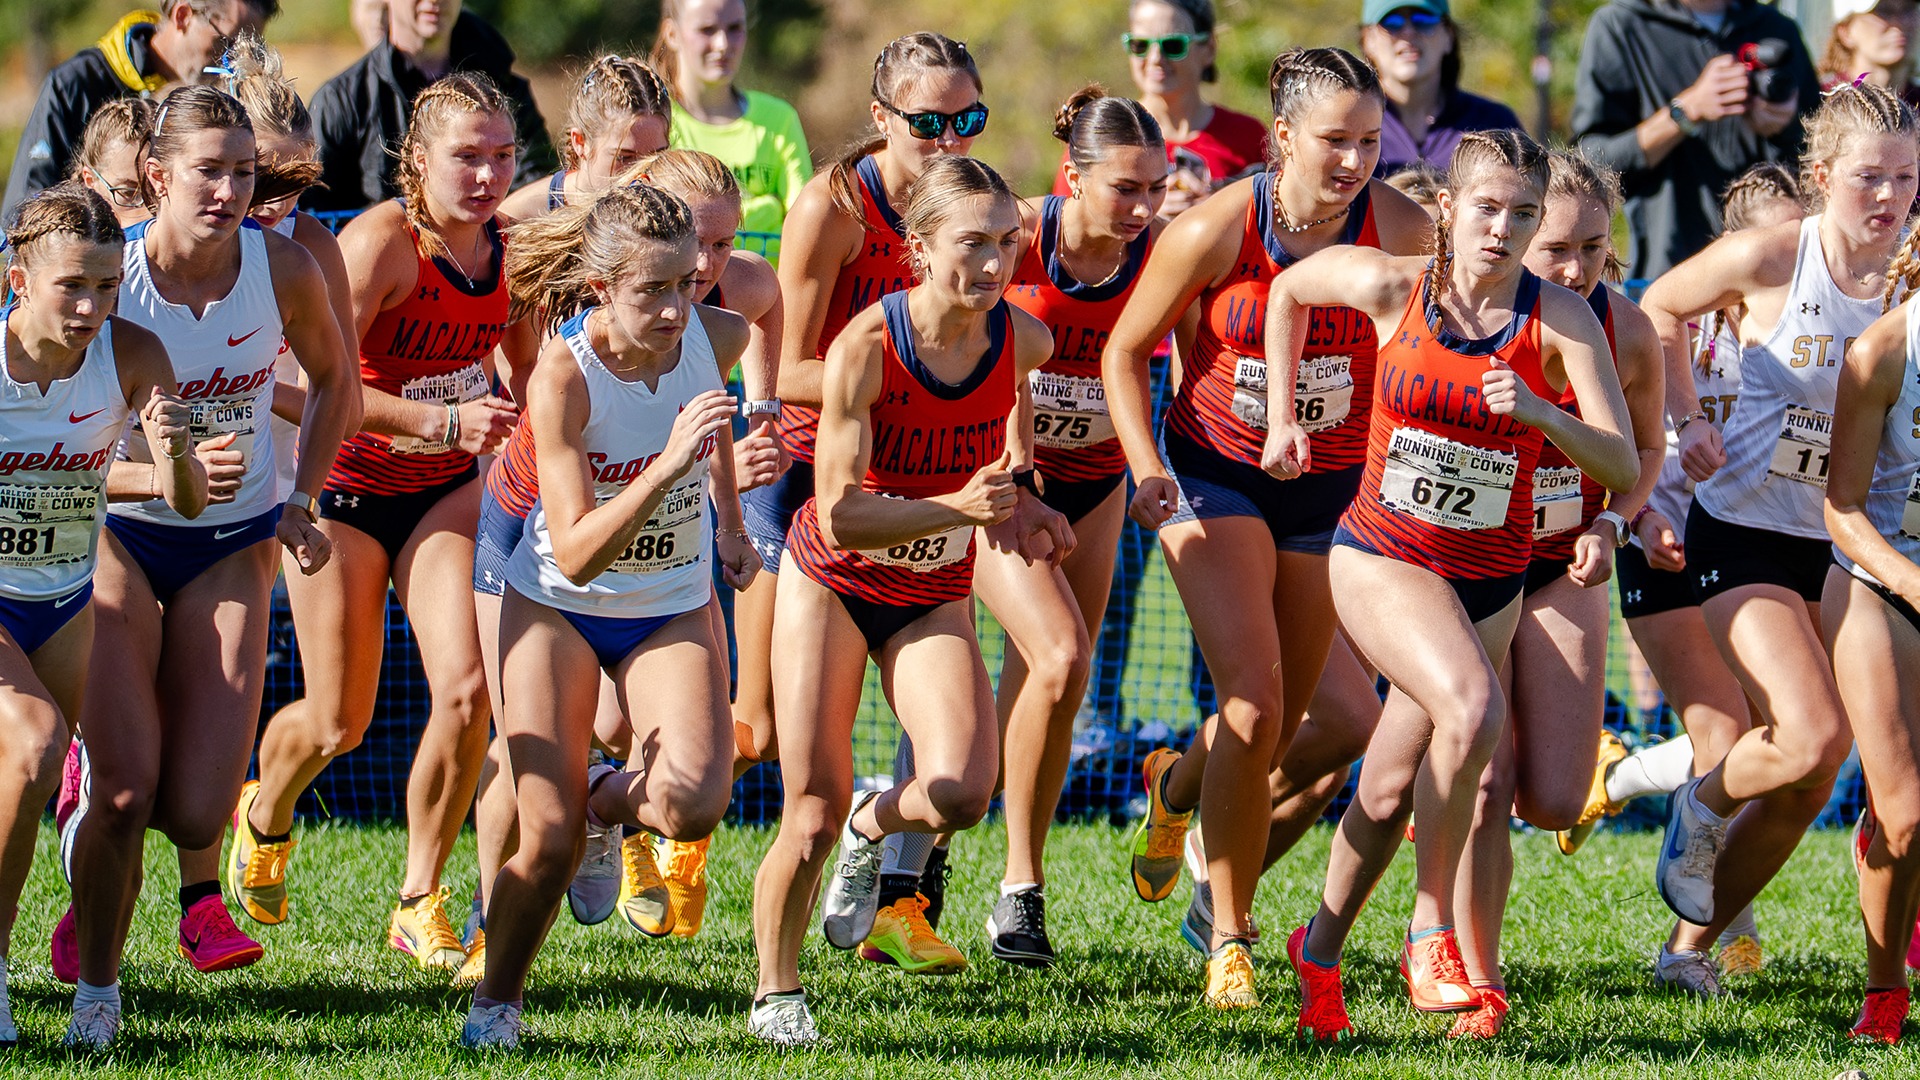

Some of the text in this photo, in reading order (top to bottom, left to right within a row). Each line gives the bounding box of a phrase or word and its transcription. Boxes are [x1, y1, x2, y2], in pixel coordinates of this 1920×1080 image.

[1789, 335, 1836, 369] ST.
[1316, 361, 1349, 380] COWS
[405, 383, 457, 400] RUNNING
[1031, 382, 1072, 398] NNING
[1087, 387, 1105, 401] CO
[1077, 380, 1104, 388] COLLEG
[216, 405, 253, 423] COWS
[1786, 414, 1833, 433] RUNNI
[1033, 413, 1092, 439] 675
[1393, 435, 1456, 465] RUNNING
[1470, 457, 1516, 477] COWS
[1419, 436, 1495, 460] CARLETON COLLEGE
[1539, 473, 1580, 489] COWS
[0, 488, 38, 498] ARLETON
[1411, 476, 1477, 518] 672
[0, 496, 37, 511] NING
[51, 496, 97, 511] COWS
[667, 492, 701, 515] COWS
[1441, 511, 1485, 528] CHAMPIONSHIP
[0, 526, 57, 555] 881
